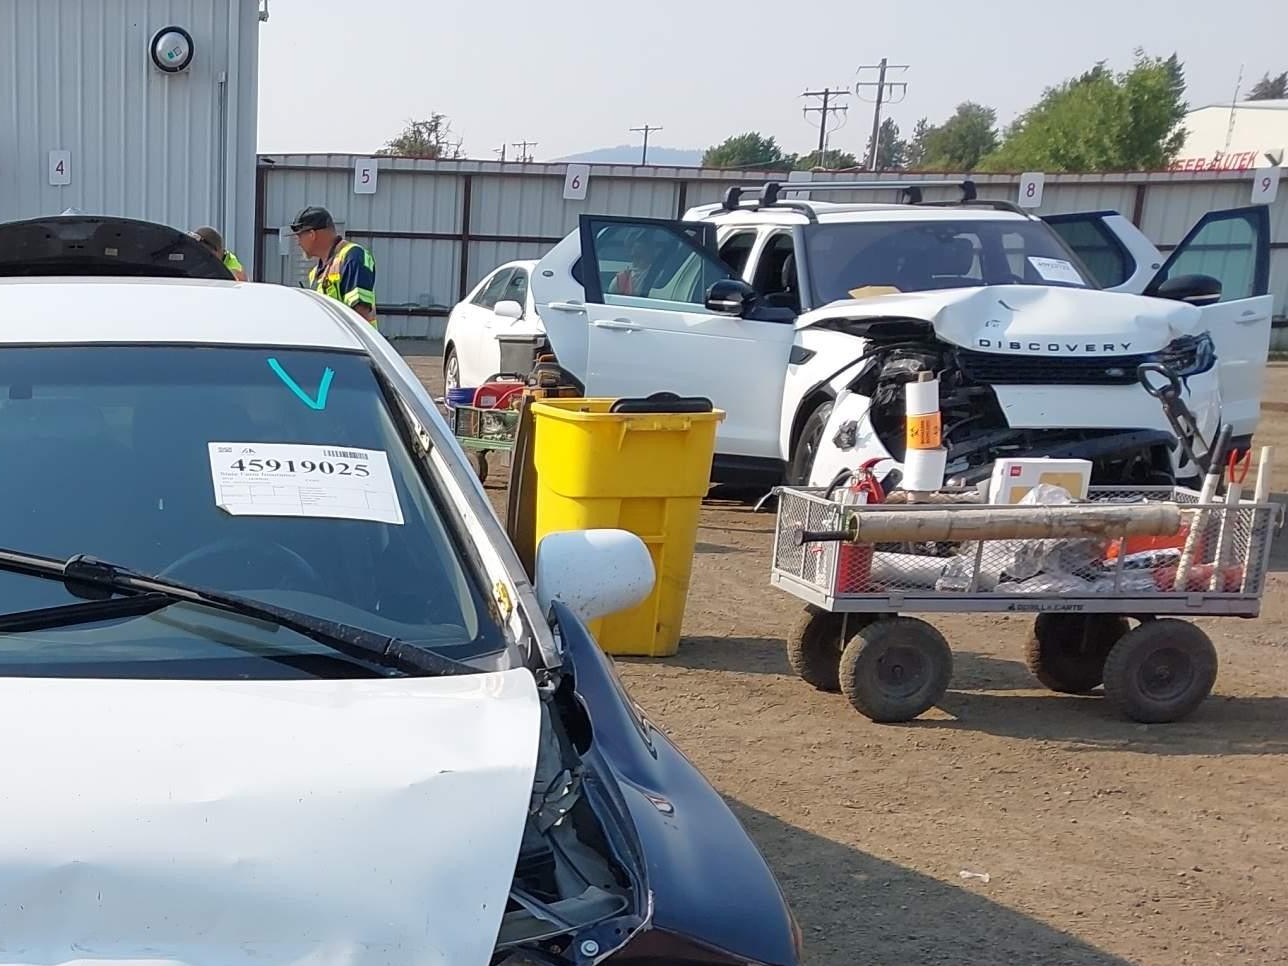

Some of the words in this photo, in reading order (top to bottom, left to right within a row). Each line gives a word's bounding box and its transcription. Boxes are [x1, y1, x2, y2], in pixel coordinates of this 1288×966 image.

[55, 160, 65, 176] 4
[362, 168, 370, 184] 5
[572, 175, 581, 190] 6
[1026, 182, 1036, 198] 8
[1262, 177, 1272, 193] 9
[978, 339, 1132, 352] DISCOVERY
[230, 458, 371, 477] 45919025
